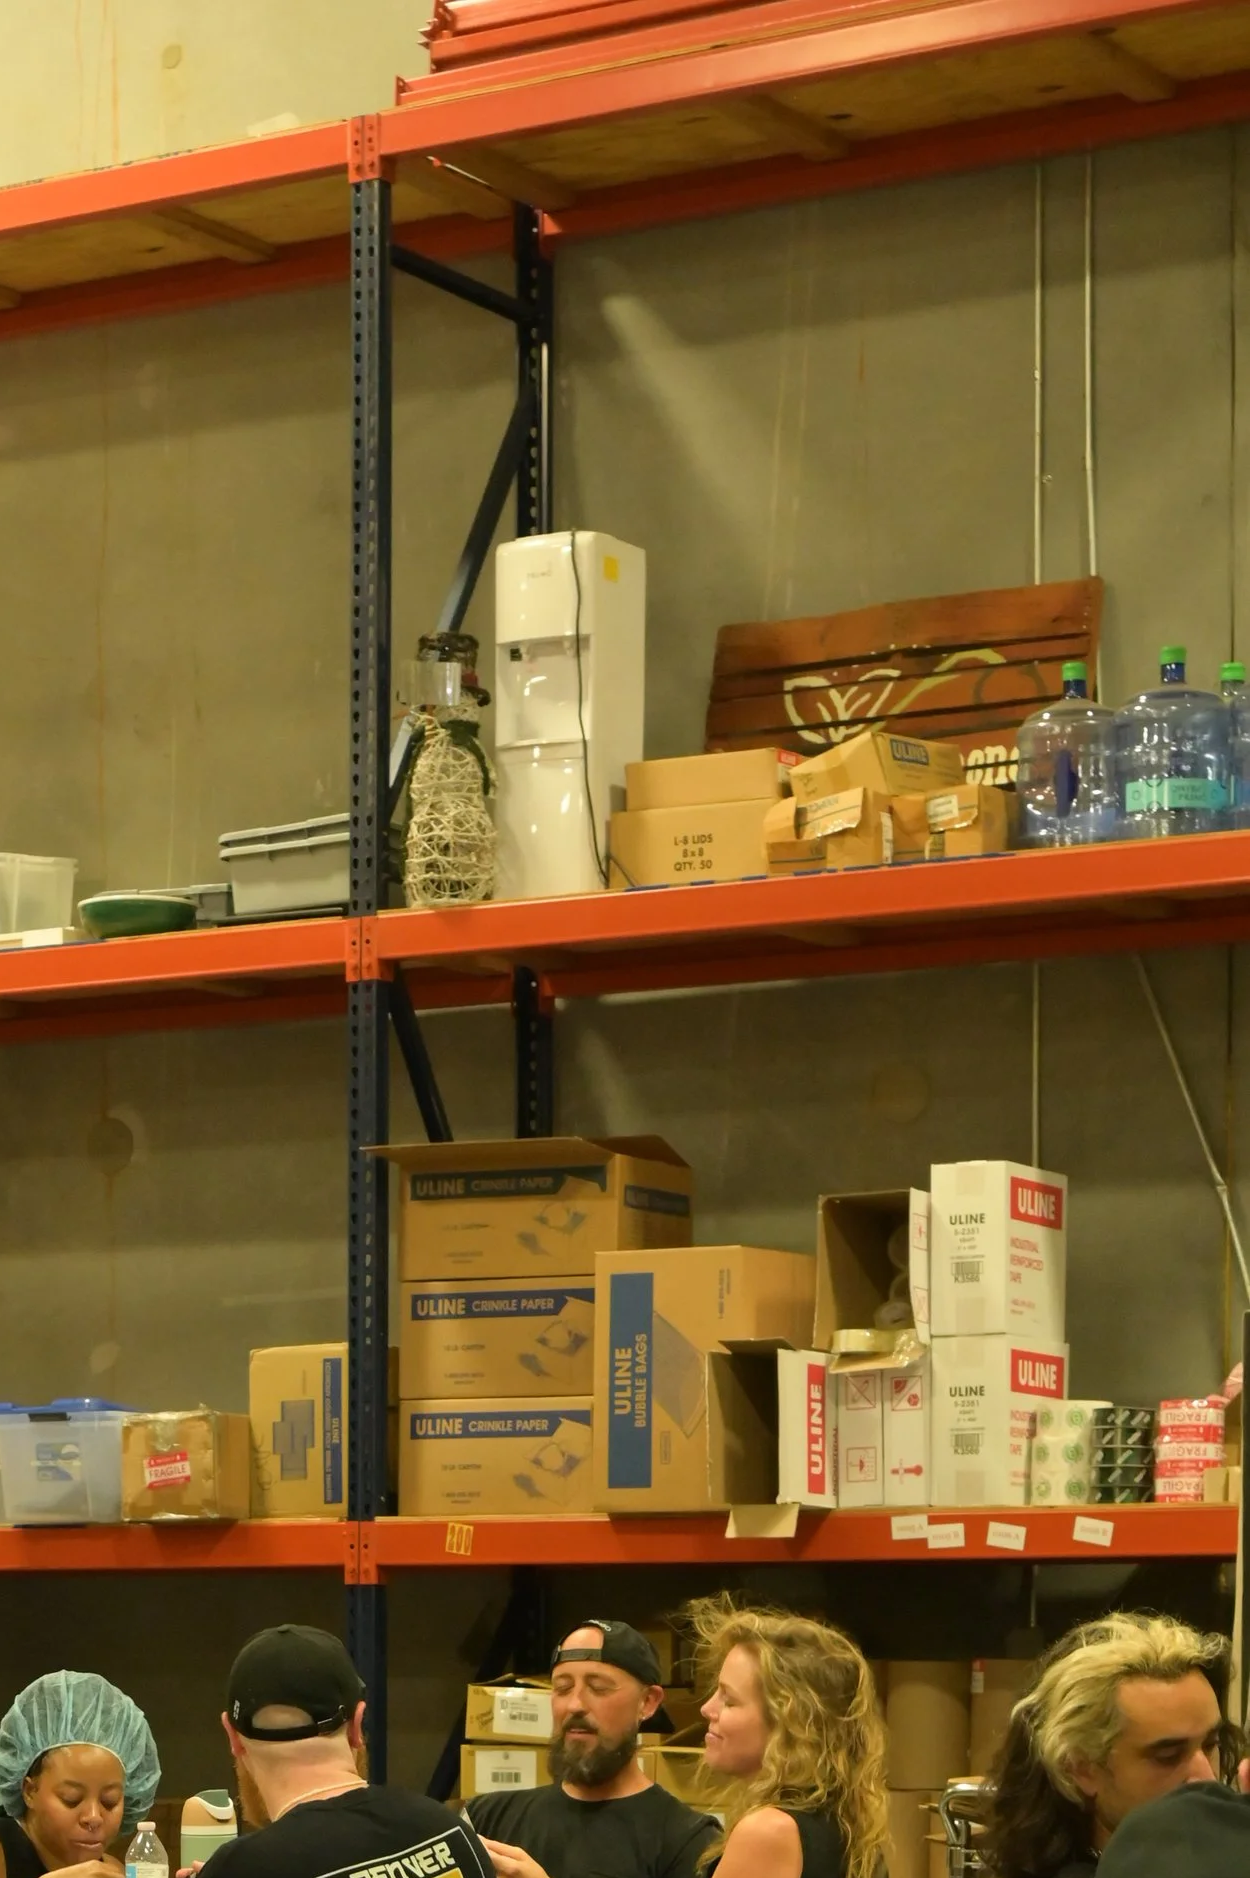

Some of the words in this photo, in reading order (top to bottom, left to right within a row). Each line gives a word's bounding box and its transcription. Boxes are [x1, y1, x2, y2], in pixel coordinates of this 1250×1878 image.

[692, 834, 713, 844] LIDS
[682, 849, 688, 858] 8
[698, 847, 704, 857] 8
[674, 862, 696, 872] QTY.
[699, 860, 713, 870] 50
[416, 1178, 465, 1196] ULINE
[520, 1176, 554, 1189] PAPER
[1017, 1187, 1056, 1220] ULINE
[950, 1213, 985, 1225] ULINE
[416, 1298, 467, 1316] ULINE
[471, 1300, 518, 1312] CRINKLE
[520, 1298, 555, 1310] PAPER
[635, 1333, 647, 1373] BAGS
[614, 1347, 632, 1415] ULINE
[1019, 1359, 1058, 1391] ULINE
[949, 1386, 985, 1397] ULINE
[634, 1378, 647, 1428] BUBBLE
[416, 1418, 463, 1436] ULINE
[468, 1421, 513, 1432] CRINKLE
[516, 1419, 549, 1431] PAPER
[811, 1384, 823, 1474] ULINE
[149, 1463, 187, 1479] FRAGILE
